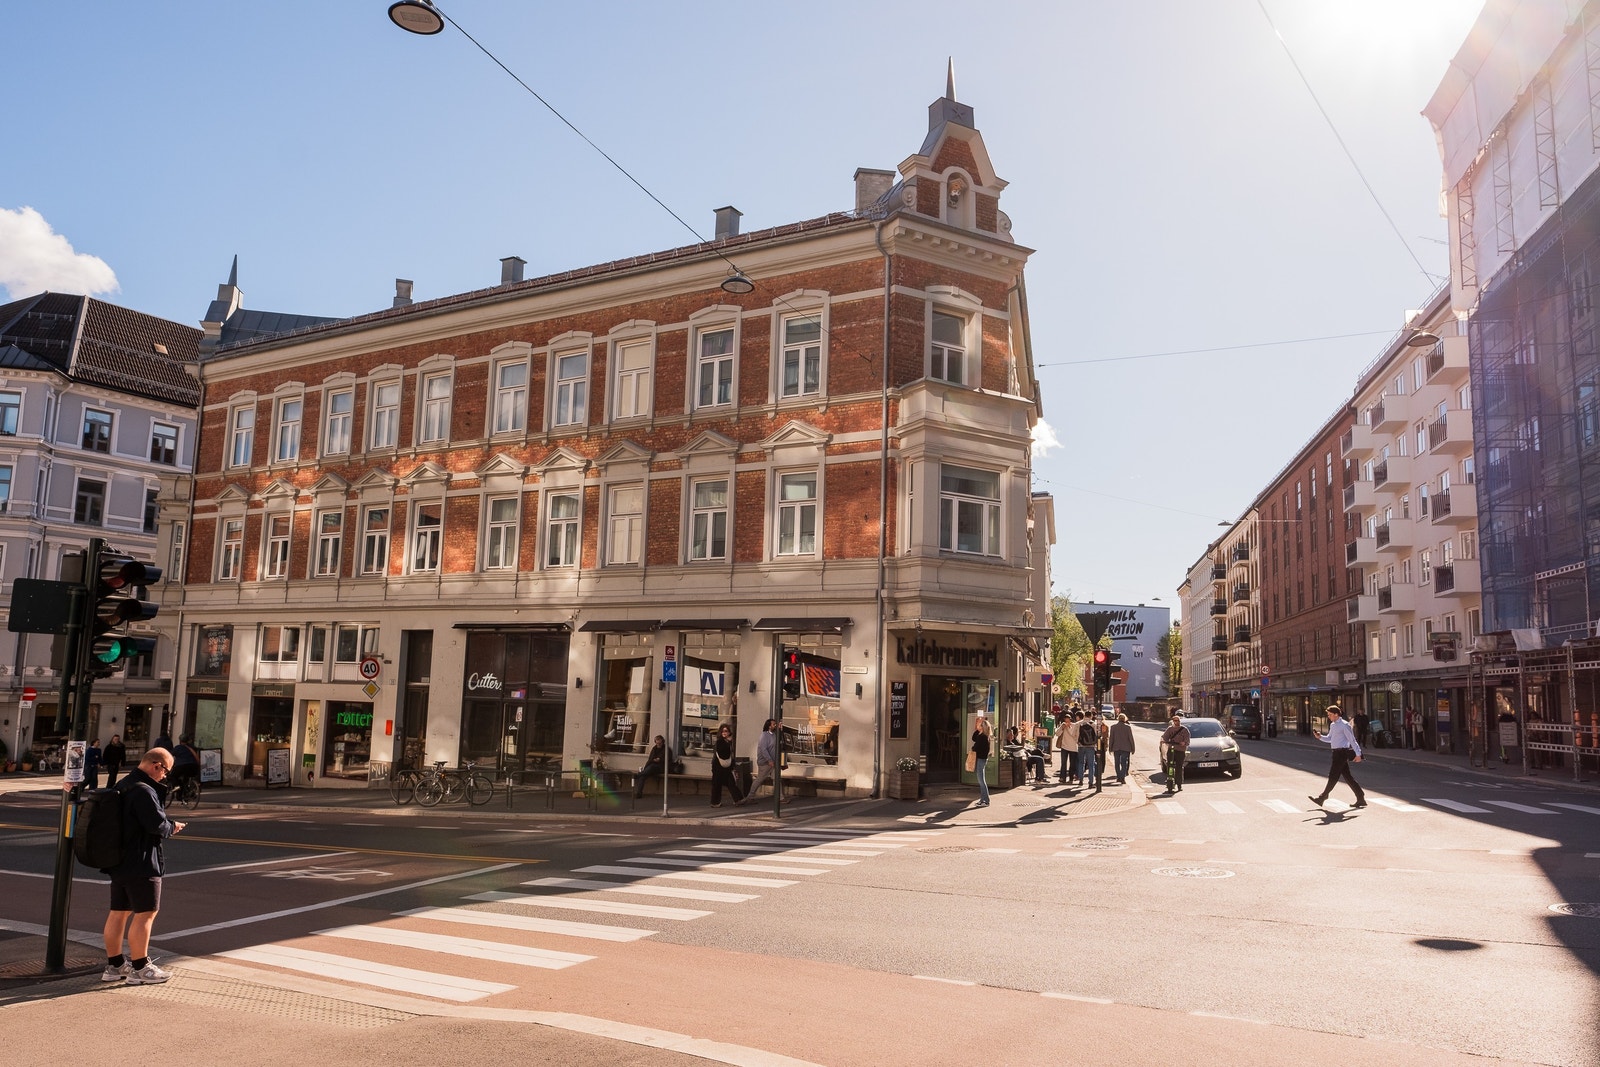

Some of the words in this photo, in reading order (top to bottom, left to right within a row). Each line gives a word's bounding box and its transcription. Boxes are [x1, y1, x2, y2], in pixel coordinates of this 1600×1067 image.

[1107, 622, 1144, 637] RATION
[897, 637, 999, 668] Kaffebrenneriet
[364, 662, 376, 673] 40
[336, 712, 374, 727] røtter
